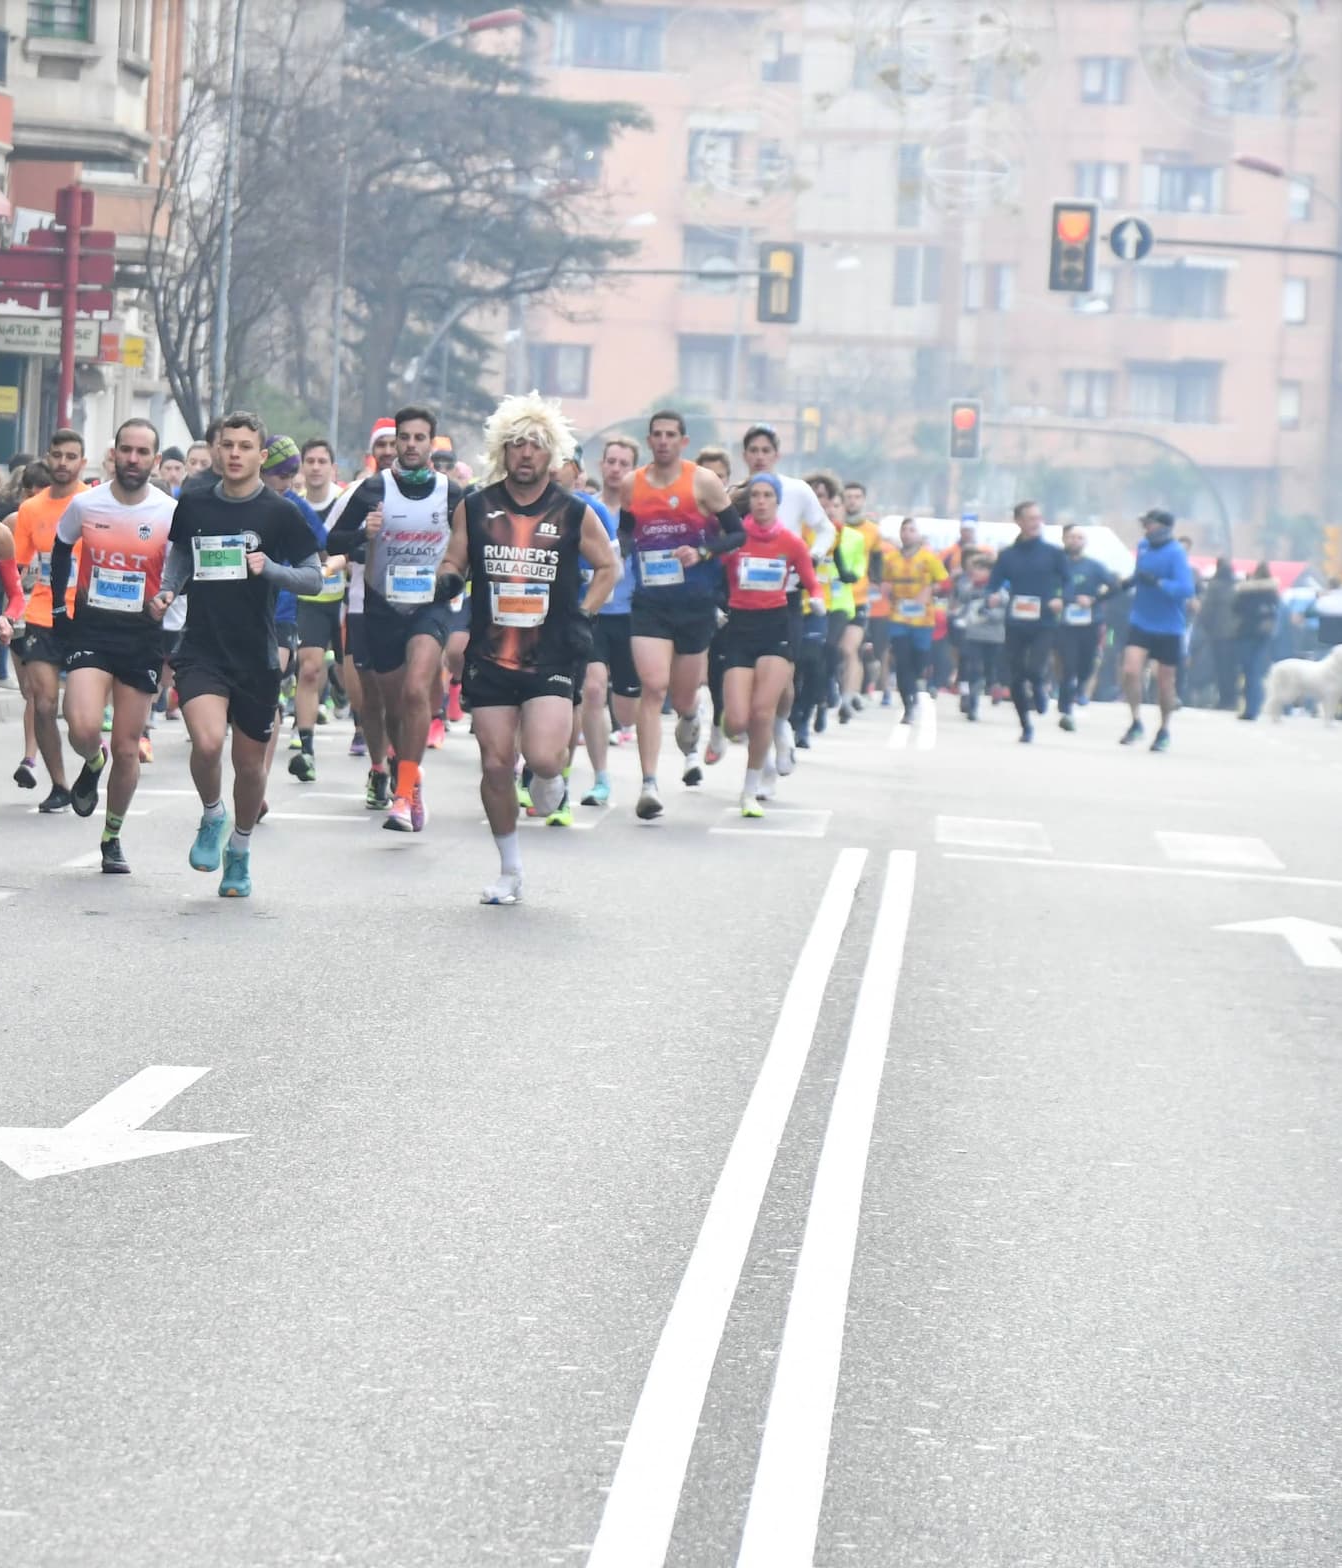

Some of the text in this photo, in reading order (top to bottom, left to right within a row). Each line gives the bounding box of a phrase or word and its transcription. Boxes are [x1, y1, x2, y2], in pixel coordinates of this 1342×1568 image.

[208, 550, 230, 561] POL
[484, 545, 559, 565] RUNNER'S
[486, 561, 555, 578] BALAGUER
[99, 581, 136, 593] XAVIER
